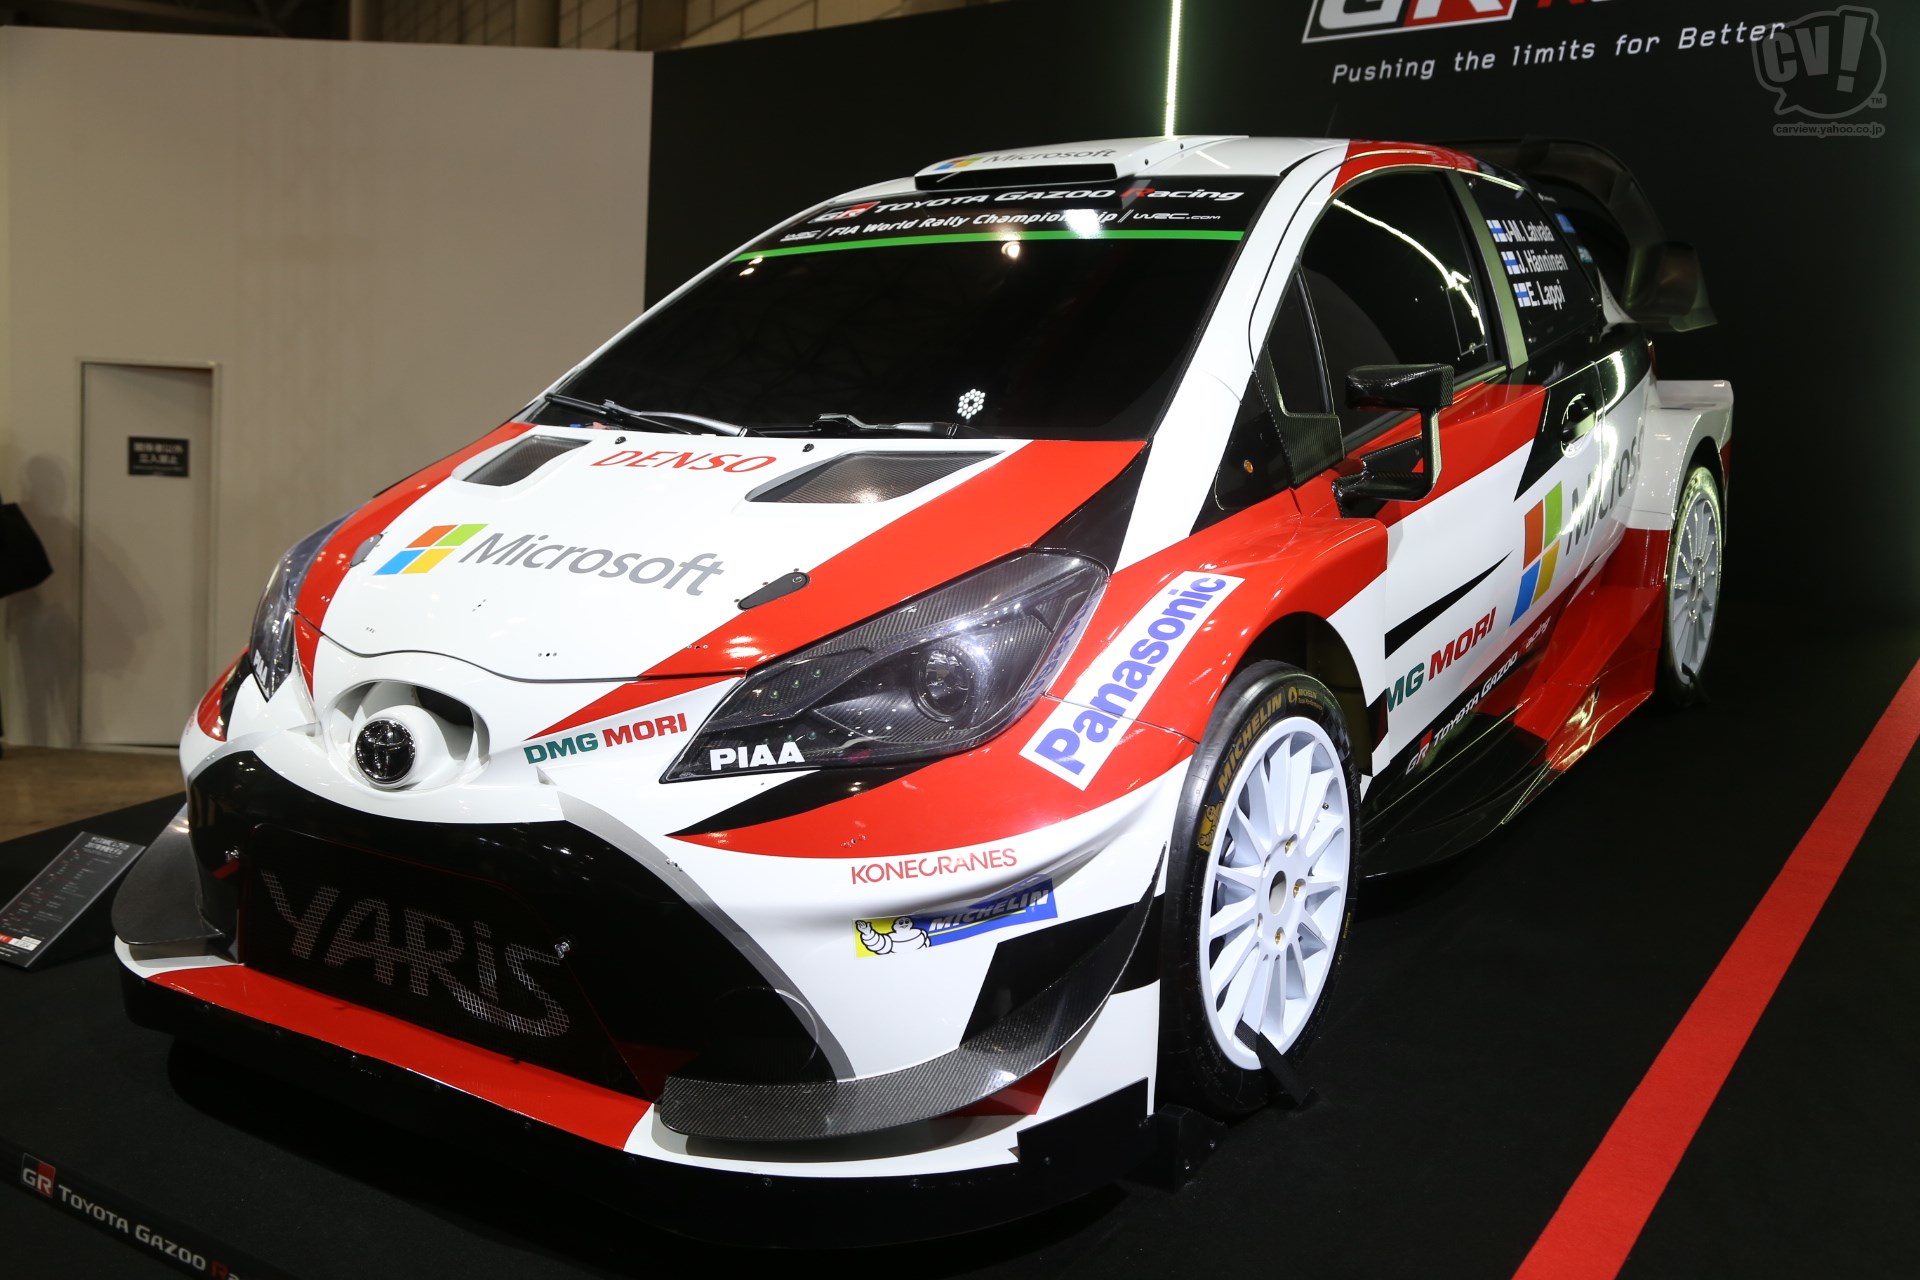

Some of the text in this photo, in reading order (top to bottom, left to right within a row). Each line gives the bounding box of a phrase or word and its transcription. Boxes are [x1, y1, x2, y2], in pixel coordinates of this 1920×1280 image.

[1331, 21, 1786, 84] Pushing the limits for Better
[983, 149, 1117, 164] Microsoft
[874, 194, 989, 213] TOYOTA
[994, 189, 1116, 201] GAZOO
[1120, 187, 1244, 201] Racing
[827, 226, 860, 237] FIA
[862, 219, 920, 233] World
[918, 213, 970, 229] Rally
[1525, 278, 1566, 311] E. Lappi
[590, 450, 777, 474] DENSO
[458, 532, 726, 597] Microsoft
[1034, 577, 1226, 776] Panasonic
[1386, 606, 1497, 713] MG MORI
[1433, 692, 1480, 747] TOYOTA
[1481, 651, 1519, 698] GAZOO
[524, 713, 688, 764] DMG MORI
[710, 741, 805, 771] PIAA
[1217, 692, 1282, 794] MICHELIN
[851, 848, 1017, 884] KONECRANES
[928, 889, 1050, 932] MICHELIN
[22, 1167, 52, 1194] GR
[58, 1184, 129, 1234] TOYOTA
[135, 1224, 206, 1272] GAZOO
